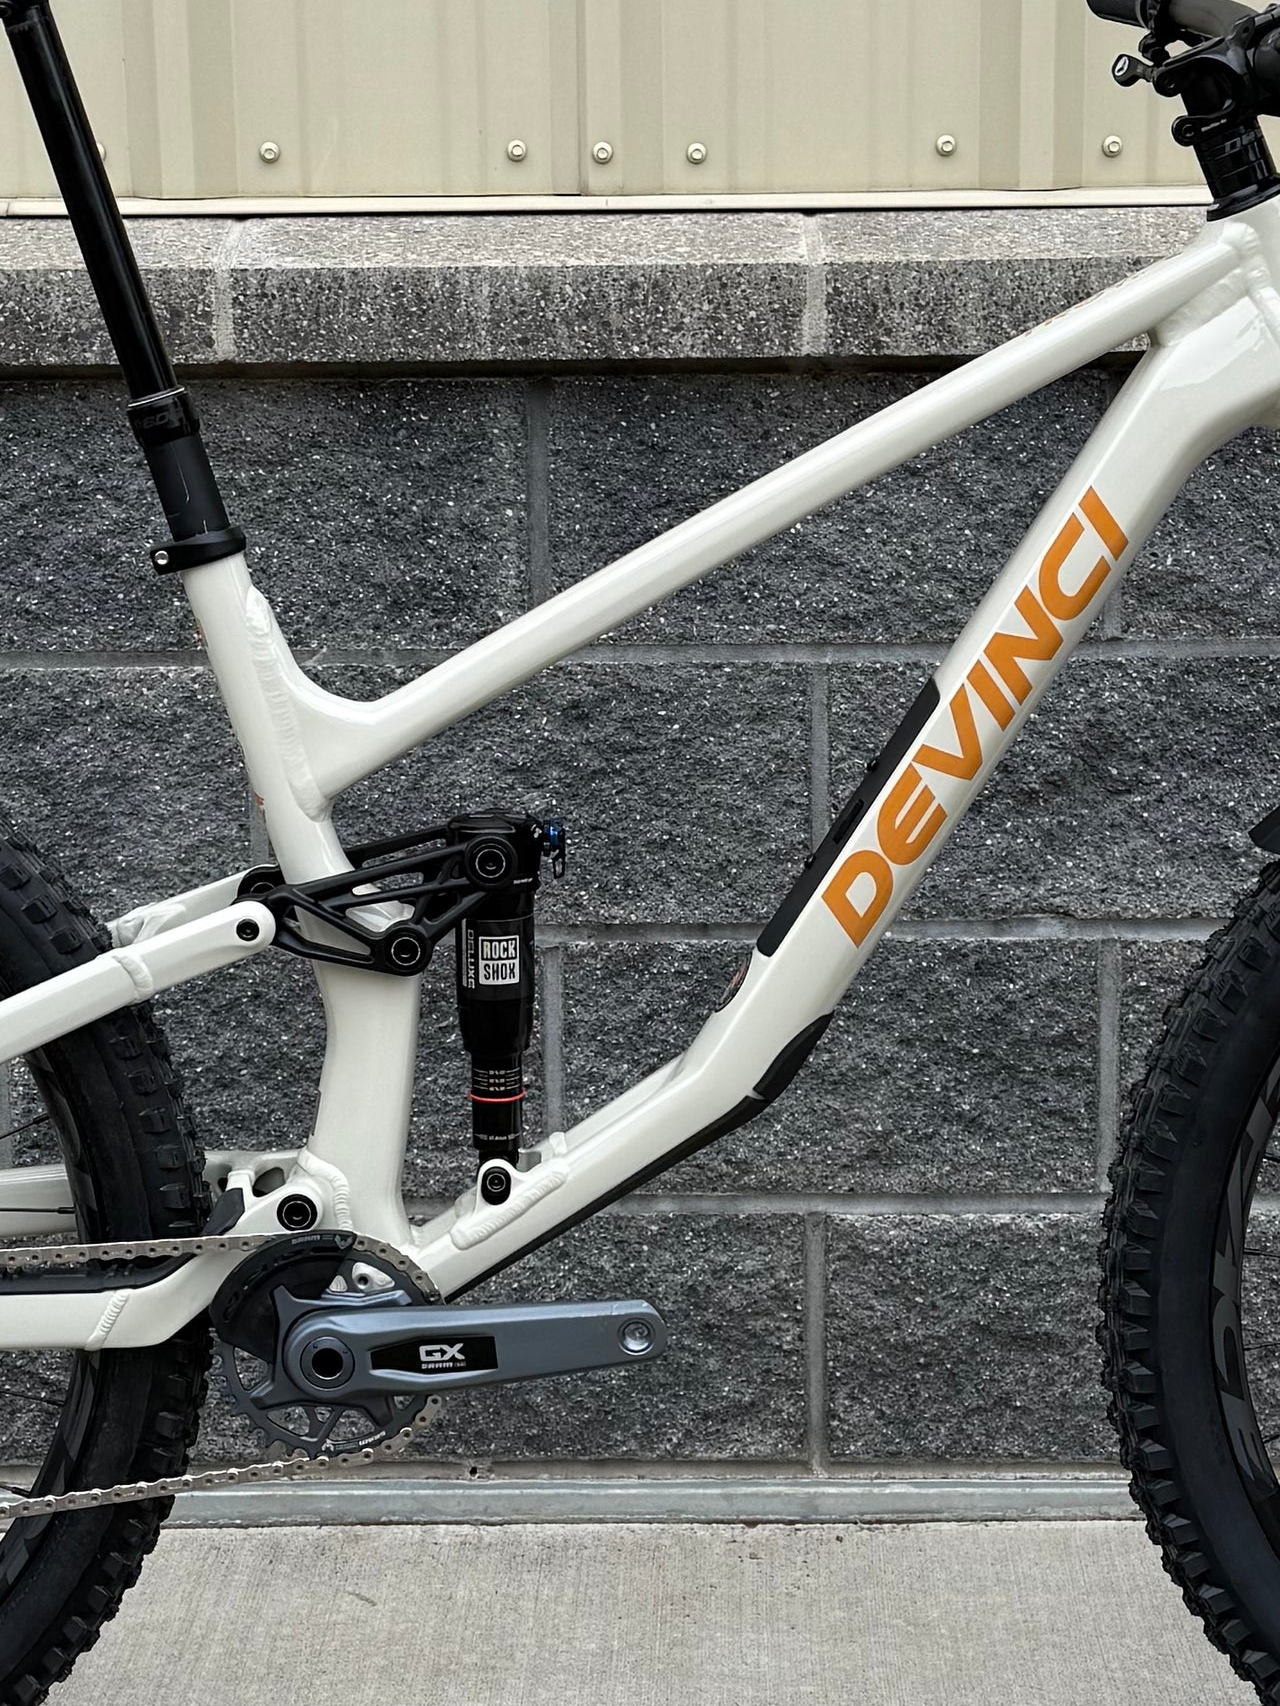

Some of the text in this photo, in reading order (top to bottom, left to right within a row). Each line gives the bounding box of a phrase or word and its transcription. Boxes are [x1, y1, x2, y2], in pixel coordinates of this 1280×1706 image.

[822, 485, 1130, 949] DEVINCI
[467, 929, 476, 990] DELUXE
[482, 940, 516, 960] ROCK
[483, 962, 516, 981] SHOX
[418, 1342, 466, 1362] GX
[421, 1362, 453, 1370] SRAM
